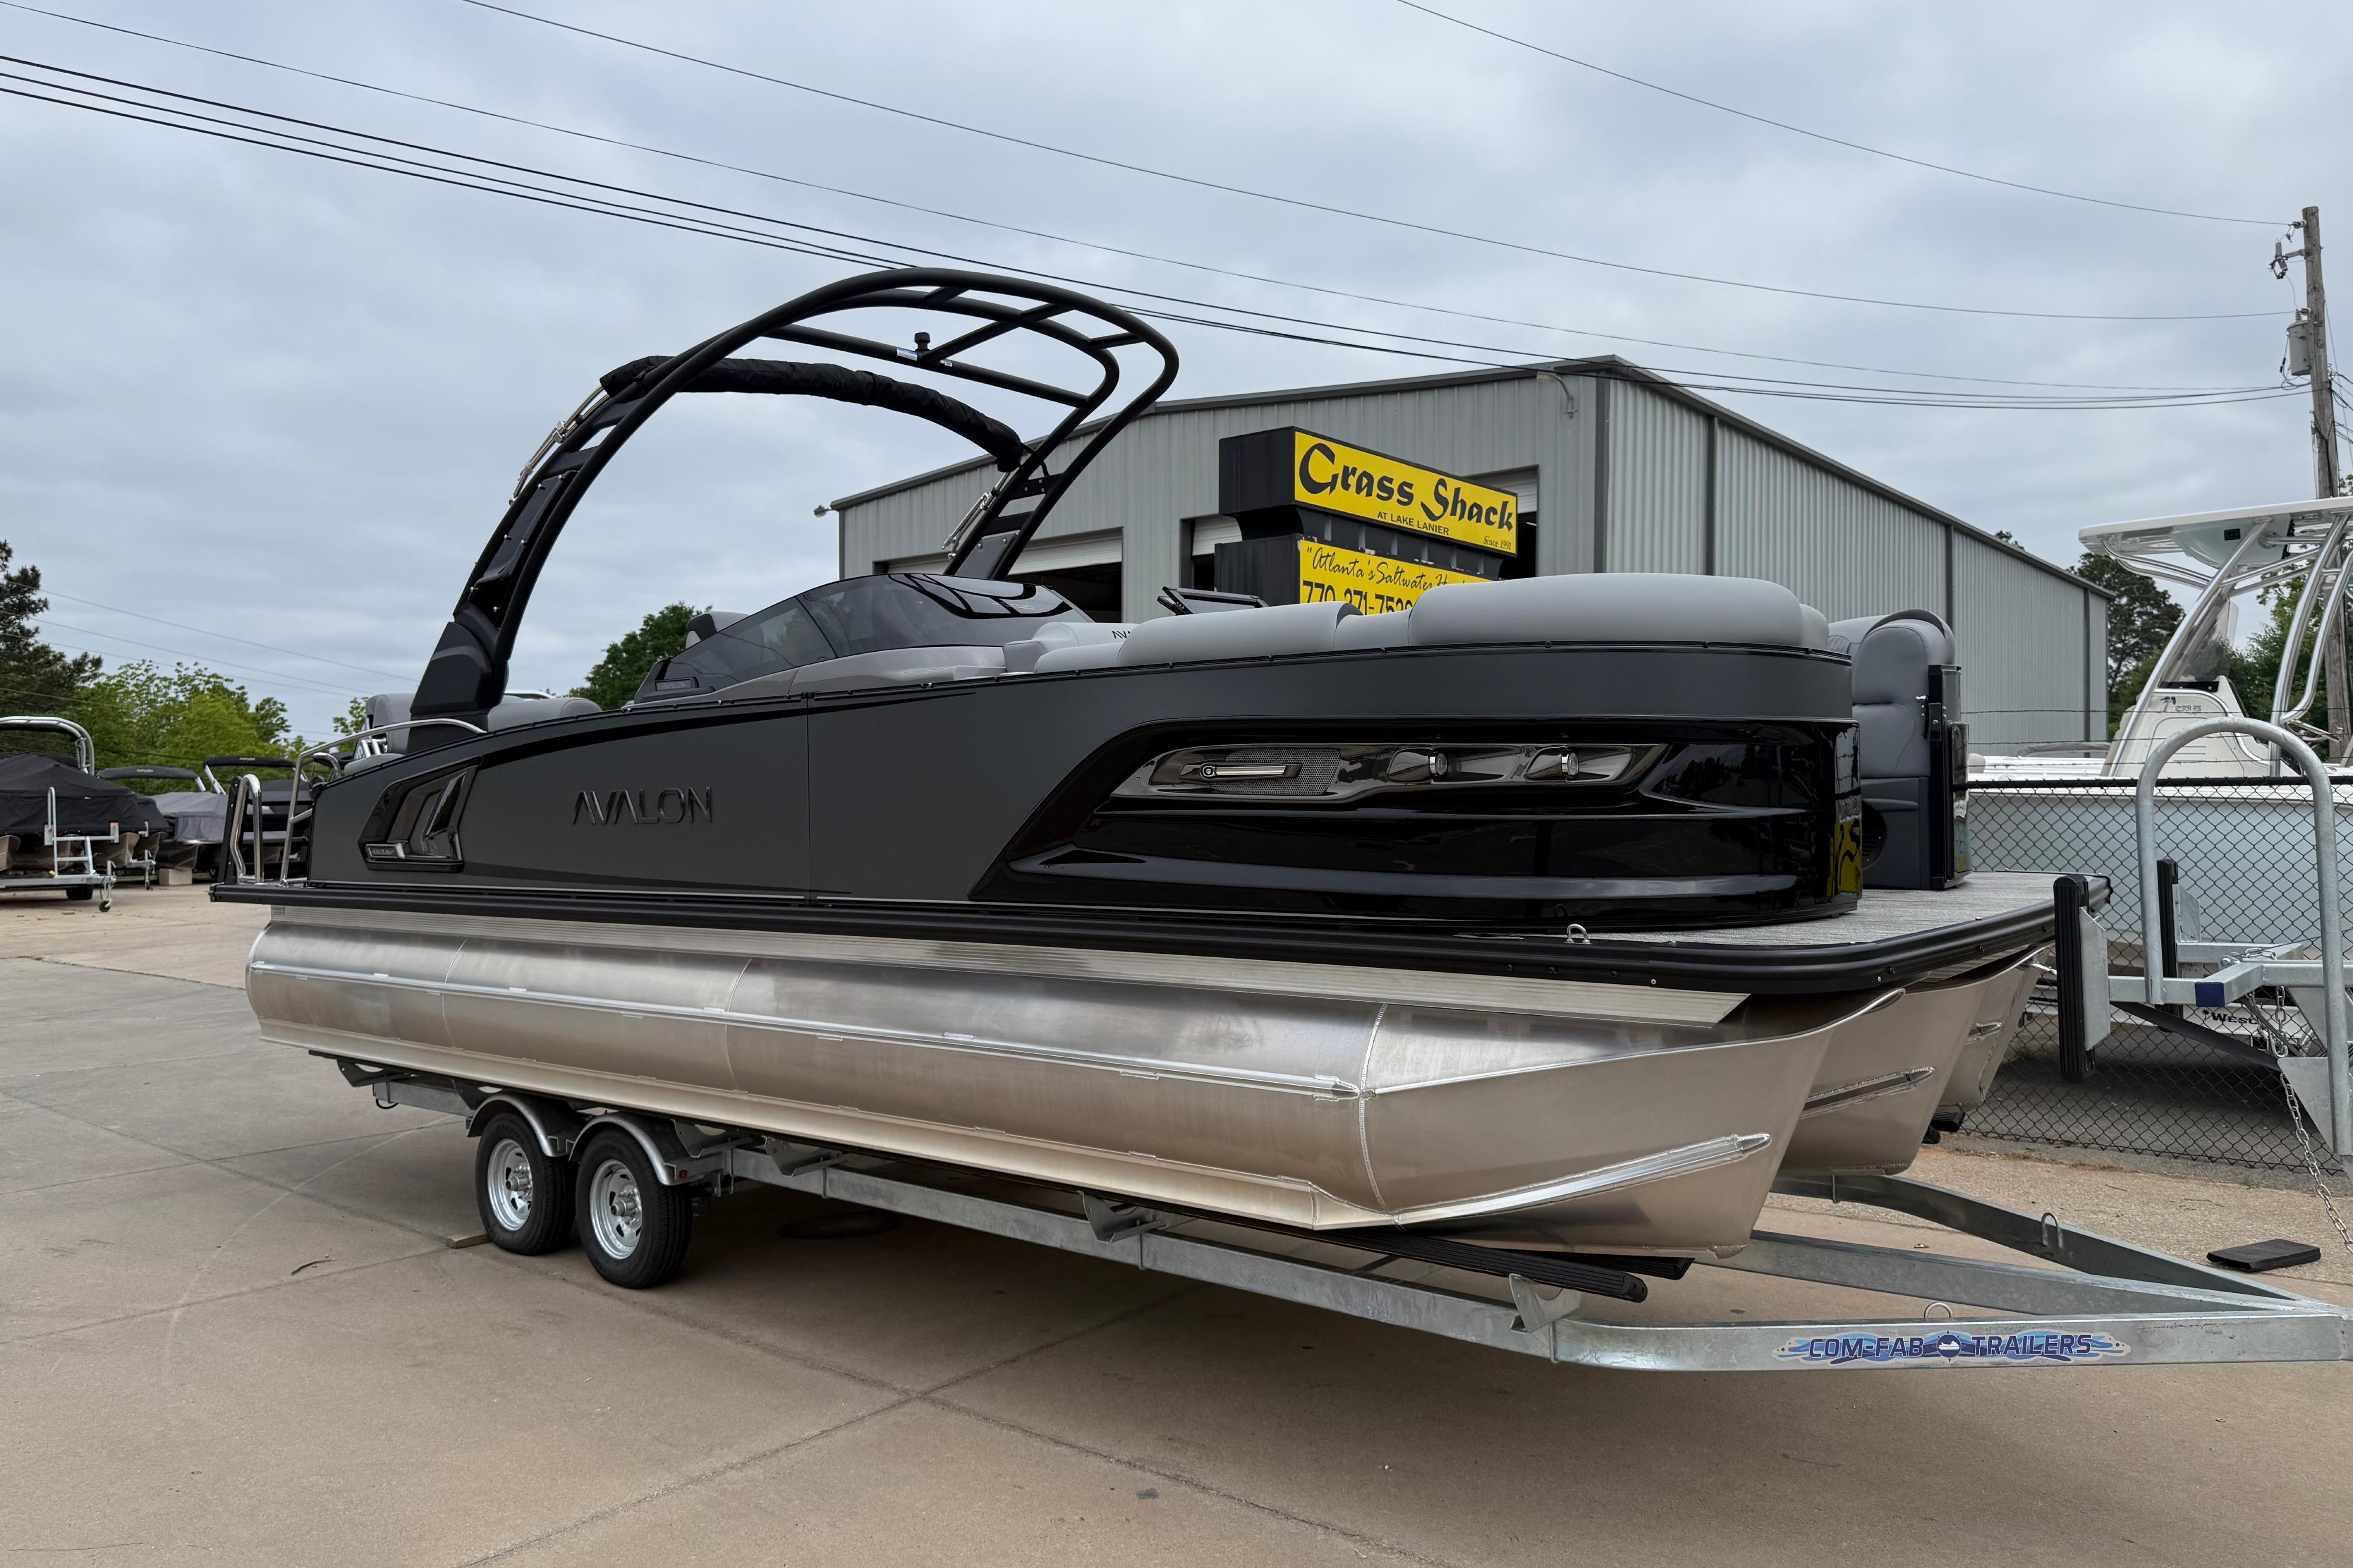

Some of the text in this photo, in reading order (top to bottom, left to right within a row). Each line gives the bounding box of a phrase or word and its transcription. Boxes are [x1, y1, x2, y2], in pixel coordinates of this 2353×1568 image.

[1299, 443, 1513, 531] Grass Shack
[1377, 511, 1449, 535] AT LAKE LANIER
[1483, 535, 1511, 550] Since 1991
[1376, 562, 1432, 590] Saltwater
[572, 786, 712, 824] AVALON
[2211, 1012, 2258, 1025] WESC
[1809, 1334, 2092, 1358] COM-FAB TRAILERS
